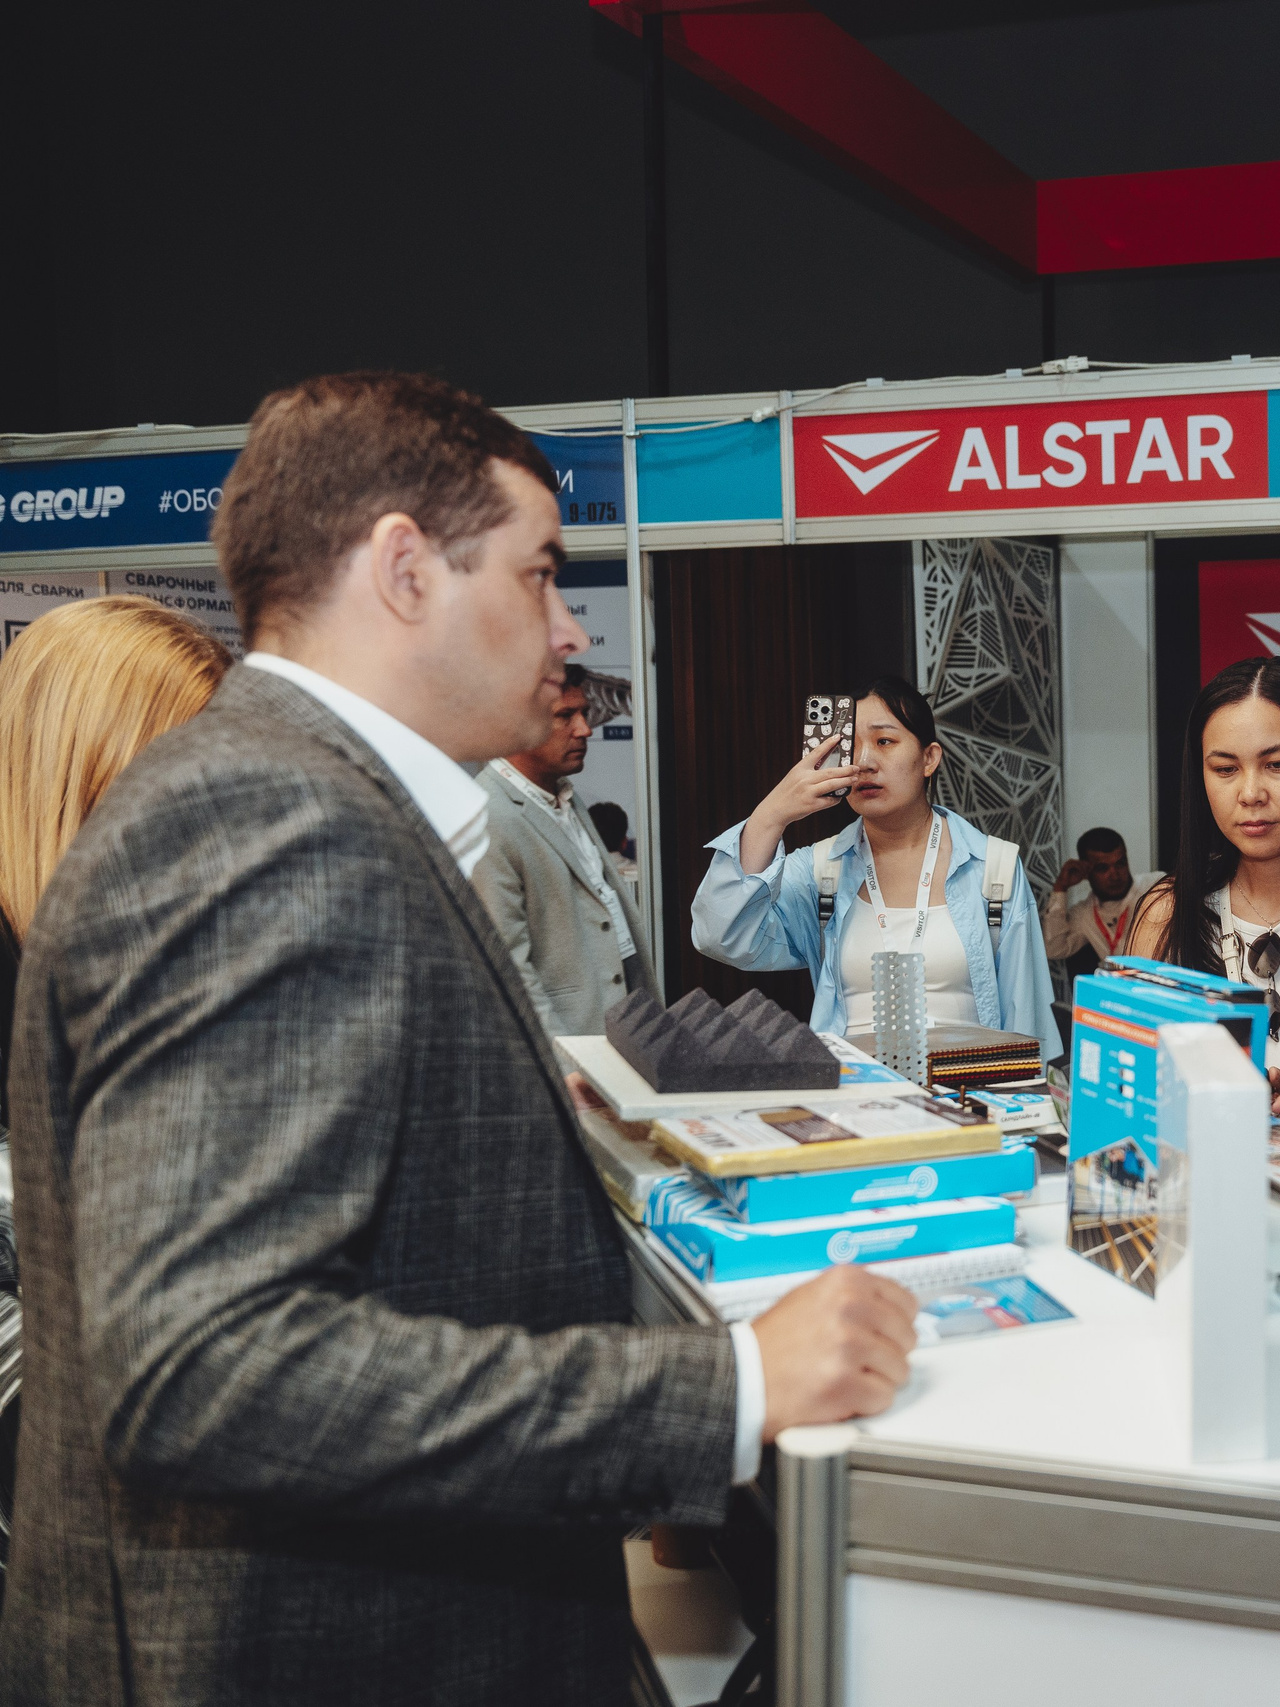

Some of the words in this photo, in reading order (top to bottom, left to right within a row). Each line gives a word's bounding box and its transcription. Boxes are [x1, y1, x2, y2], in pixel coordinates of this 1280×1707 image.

[948, 414, 1236, 493] ALSTAR
[10, 485, 125, 523] GROUP
[569, 502, 617, 523] 9-075
[125, 572, 216, 593] СВАРОЧНЫЕ
[930, 822, 941, 849] VISITOR
[866, 863, 877, 891] VISITOR
[915, 910, 925, 938] VISITOR
